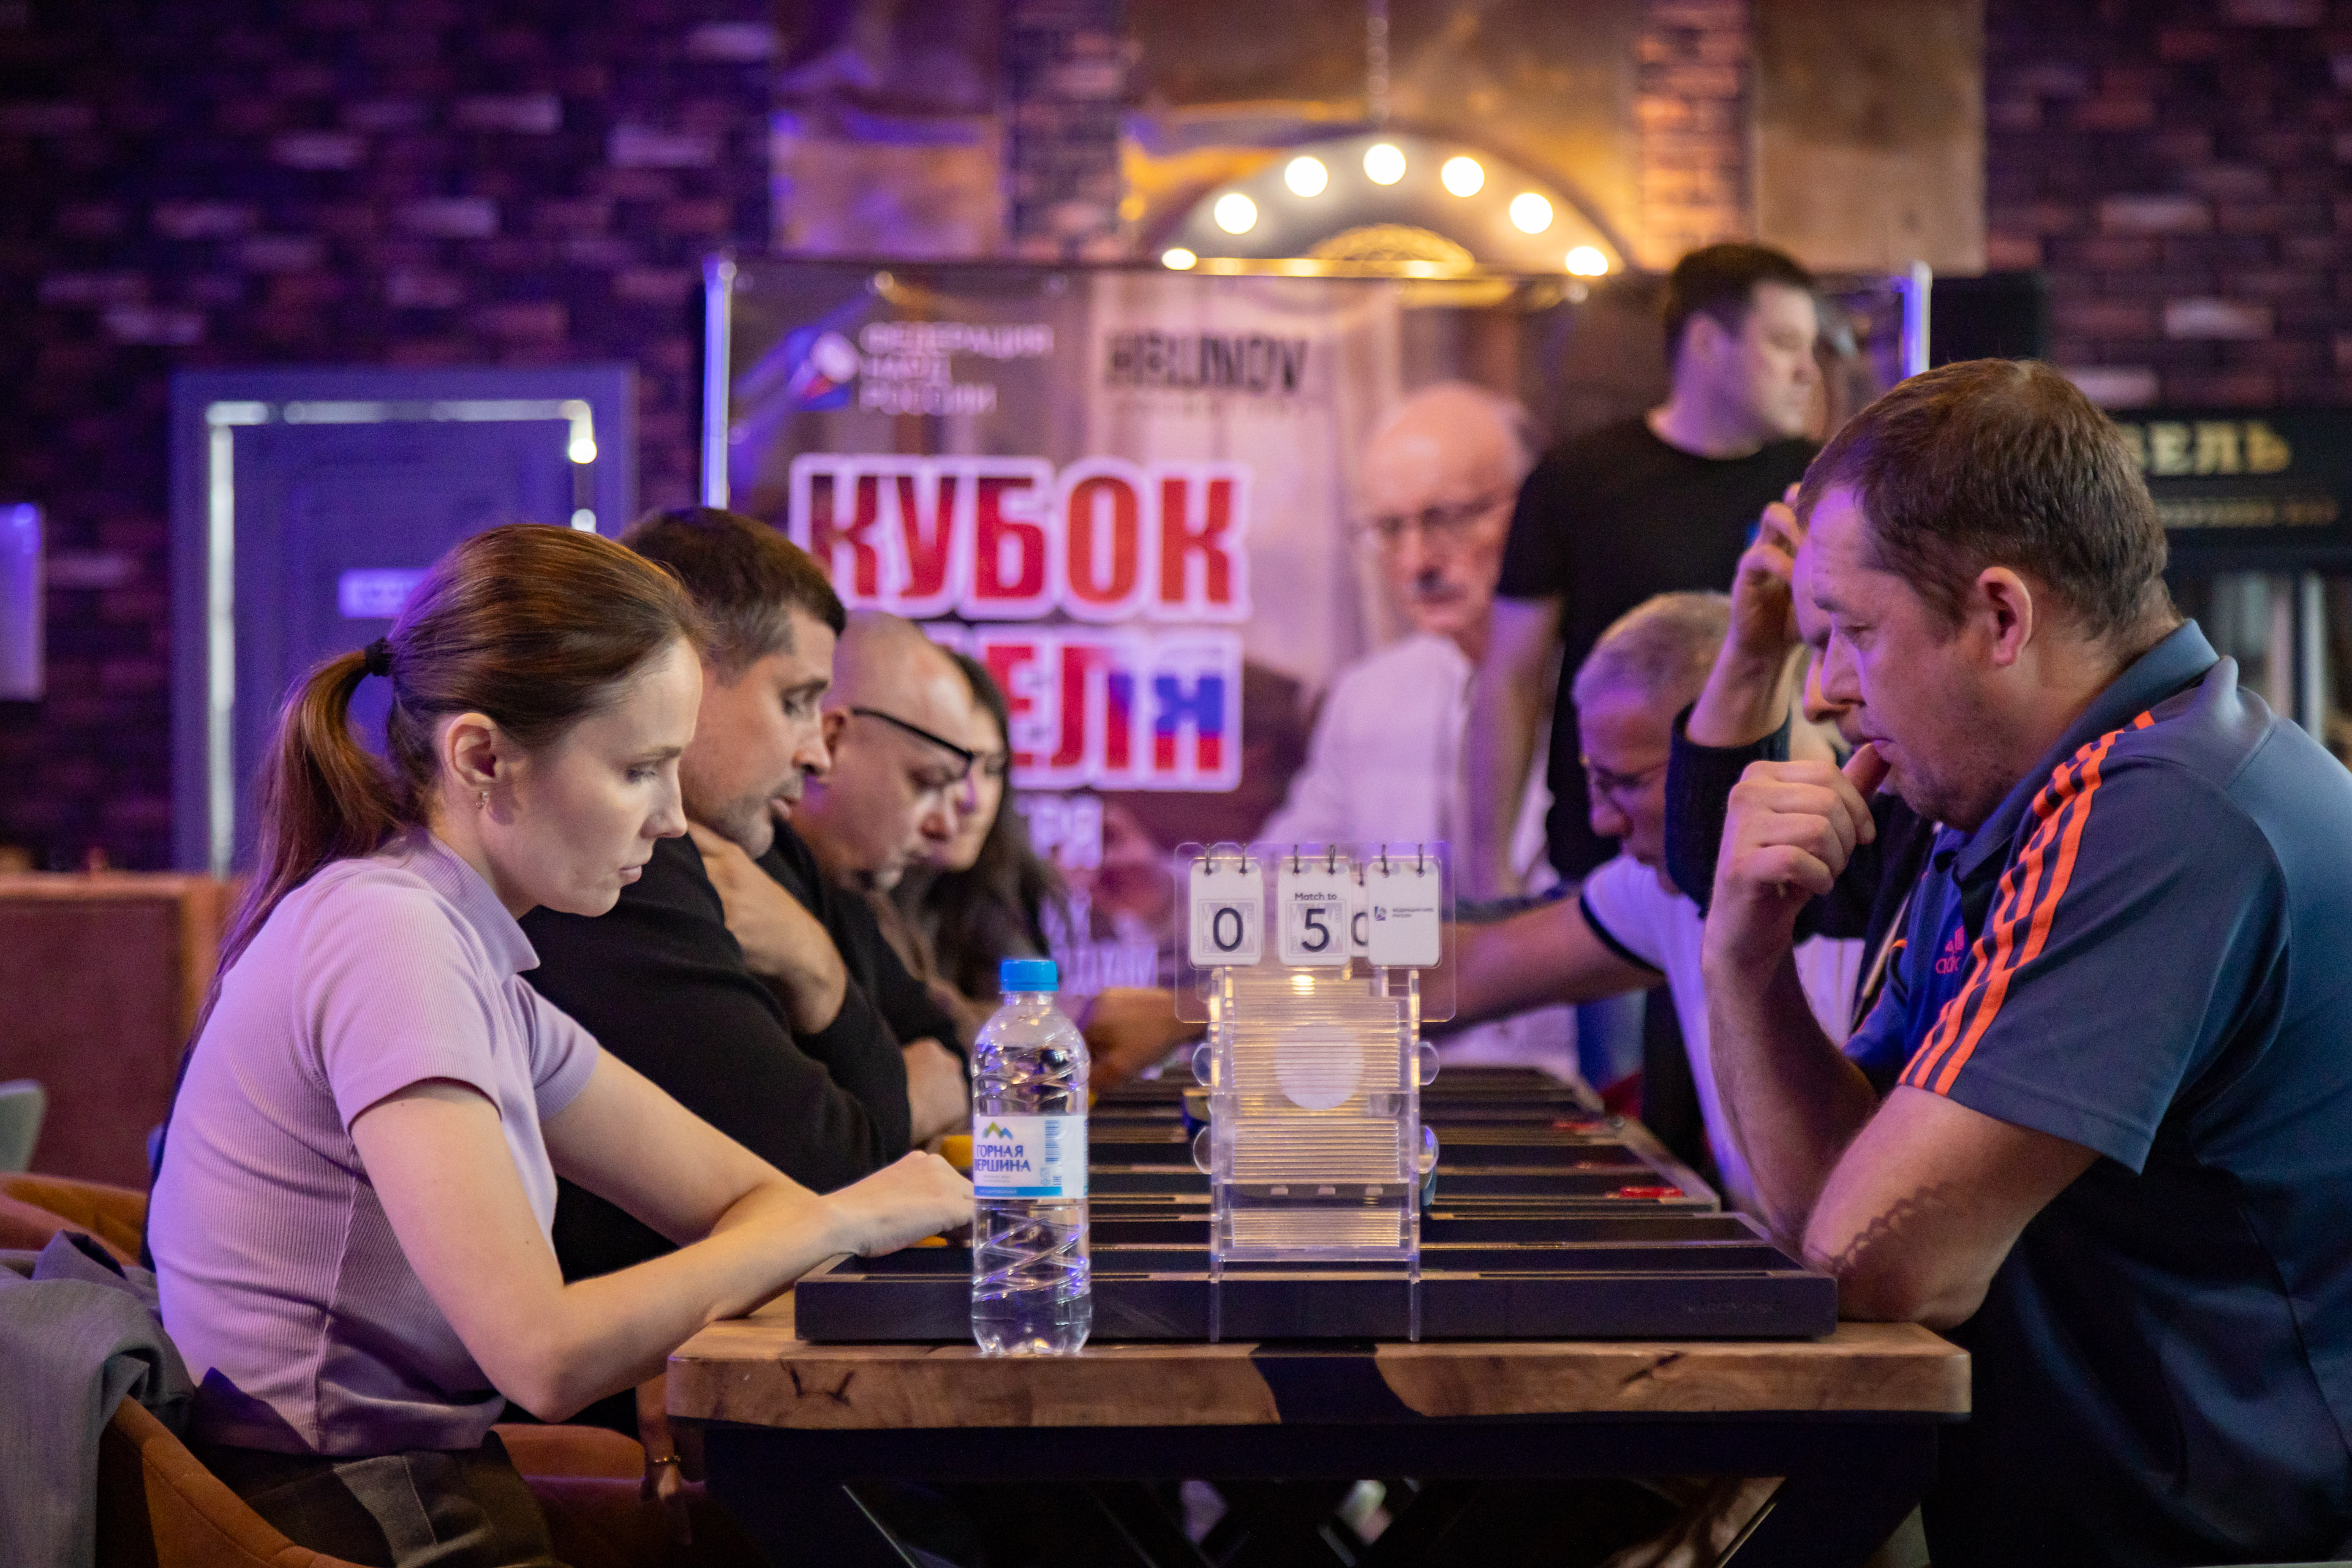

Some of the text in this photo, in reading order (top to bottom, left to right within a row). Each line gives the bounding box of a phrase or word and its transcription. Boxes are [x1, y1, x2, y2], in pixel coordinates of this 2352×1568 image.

[805, 469, 1240, 609] КУБОК
[983, 637, 1228, 775] ЕЛЯ
[1294, 892, 1325, 901] Match
[1212, 907, 1244, 952] 0
[1301, 908, 1330, 952] 5
[977, 1145, 1023, 1158] ГОРНАЯ
